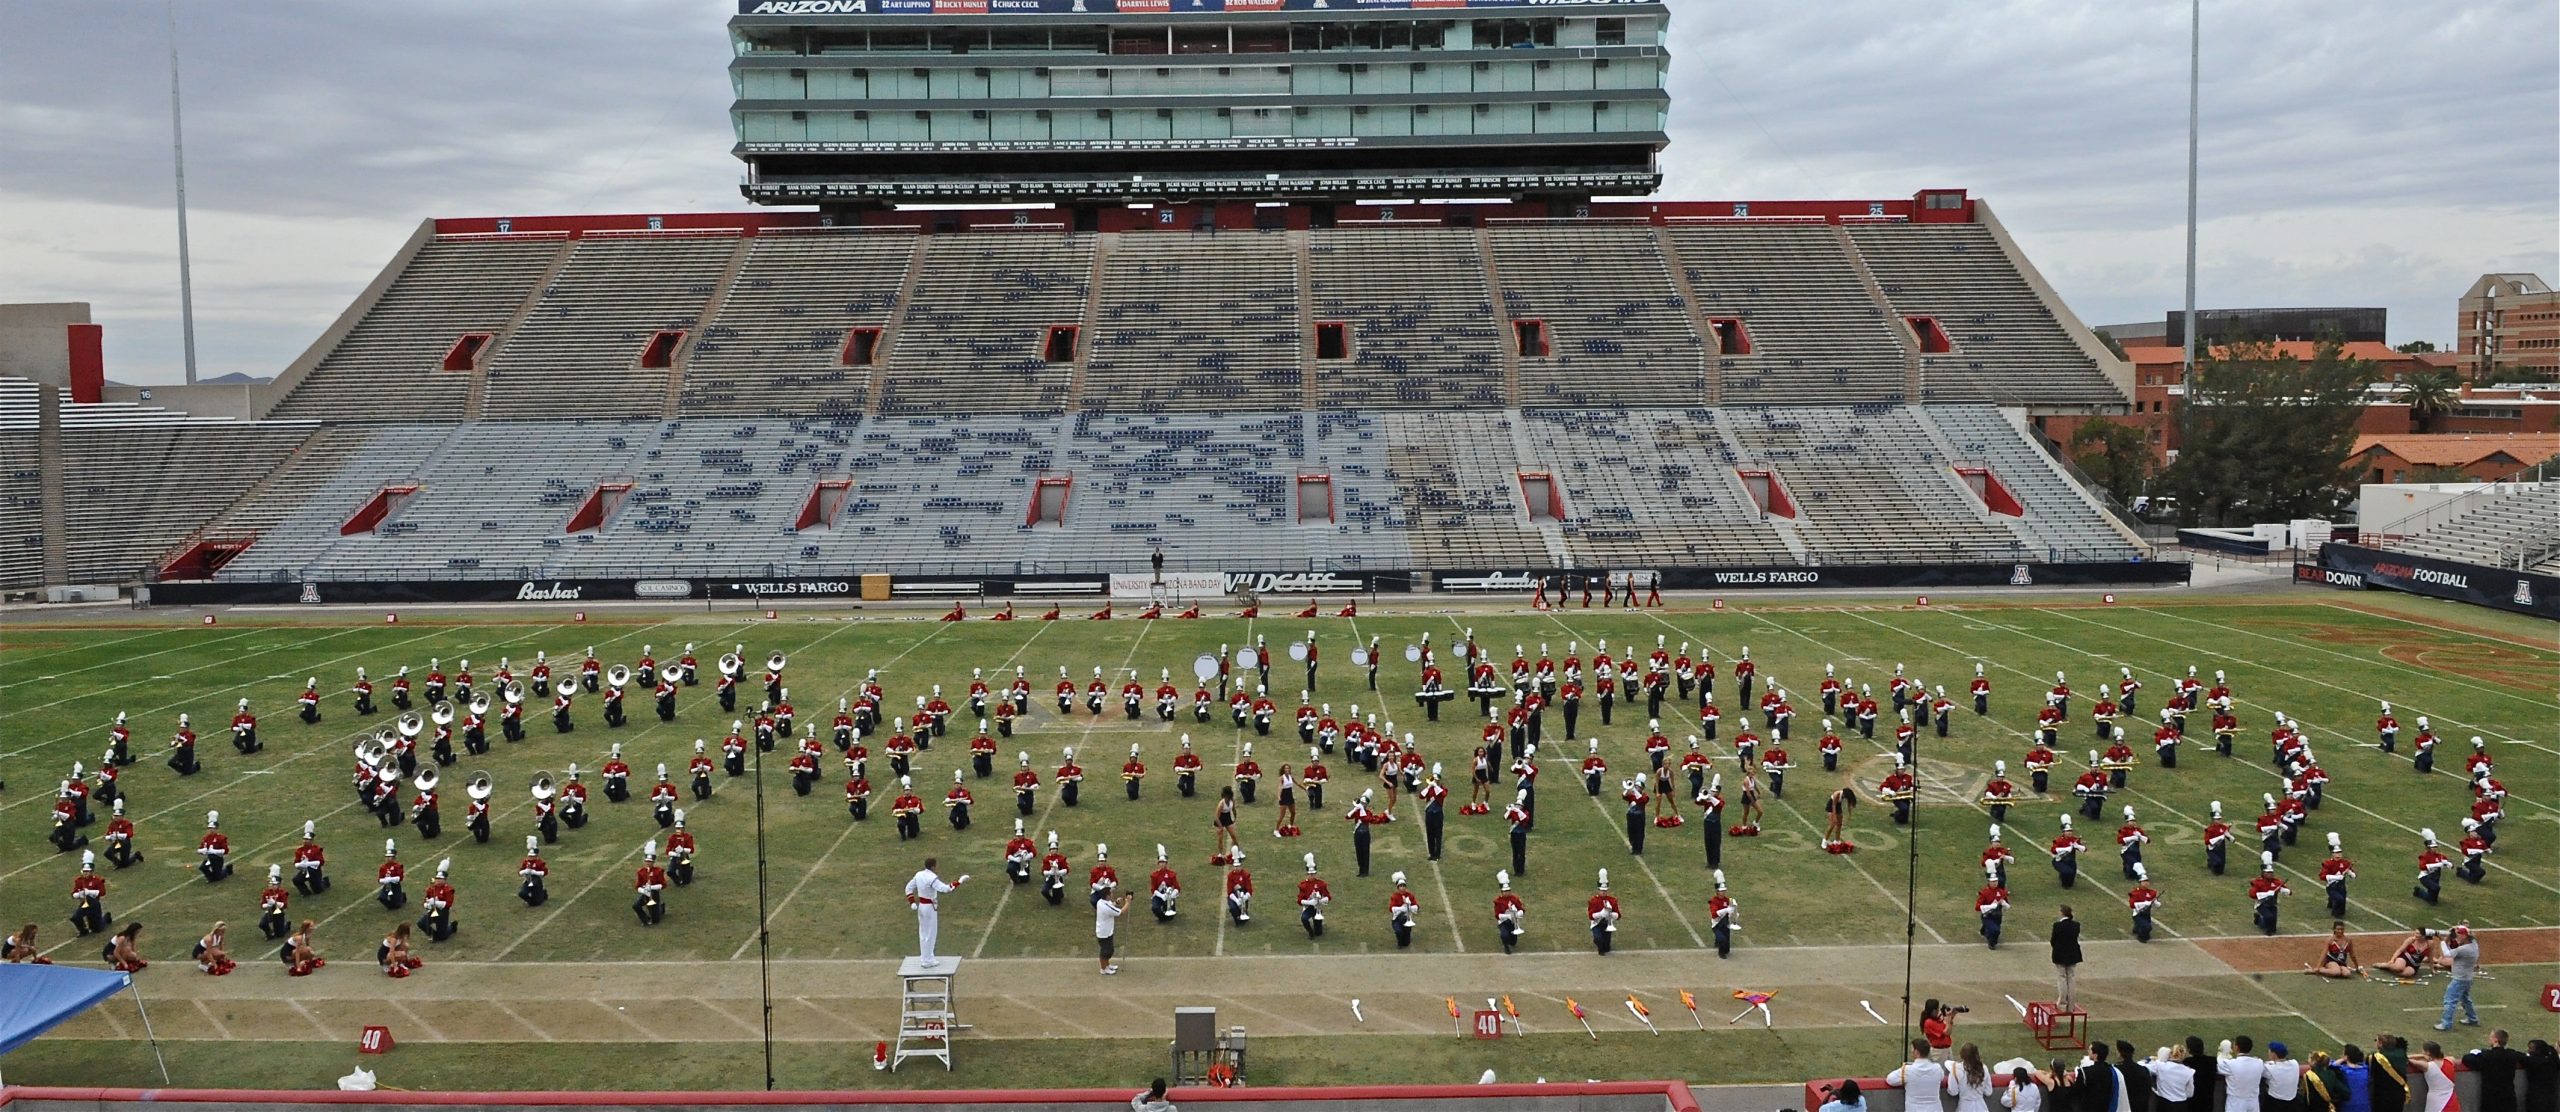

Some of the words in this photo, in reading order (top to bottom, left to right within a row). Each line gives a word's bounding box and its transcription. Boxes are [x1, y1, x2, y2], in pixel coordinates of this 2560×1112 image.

[752, 1, 866, 14] ARIZONA
[1162, 214, 1172, 222] 21
[1381, 211, 1393, 220] 22
[1576, 209, 1588, 218] 23
[1735, 208, 1746, 216] 24
[1870, 208, 1882, 216] 25
[650, 221, 660, 230] 18
[822, 218, 832, 227] 19
[1014, 216, 1027, 224] 20
[499, 224, 509, 232] 17
[141, 390, 151, 399] 16
[1715, 573, 1766, 583] WELLS
[1769, 572, 1818, 582] FARGO
[2011, 565, 2032, 584] A
[2298, 566, 2325, 579] BEAR
[2326, 571, 2361, 587] DOWN
[2373, 562, 2412, 578] ARIZONA
[2412, 568, 2468, 588] FOOTBALL
[745, 583, 796, 594] WELLS
[799, 582, 848, 592] FARGO
[1113, 580, 1147, 590] UNIVERSITY
[1189, 579, 1206, 588] BAND
[1208, 578, 1220, 588] DAY
[300, 583, 320, 602] A
[516, 582, 581, 600] Bashas'
[2514, 580, 2532, 605] A
[1478, 1015, 1496, 1034] 40
[926, 1023, 941, 1039] 50
[362, 1030, 381, 1049] 40
